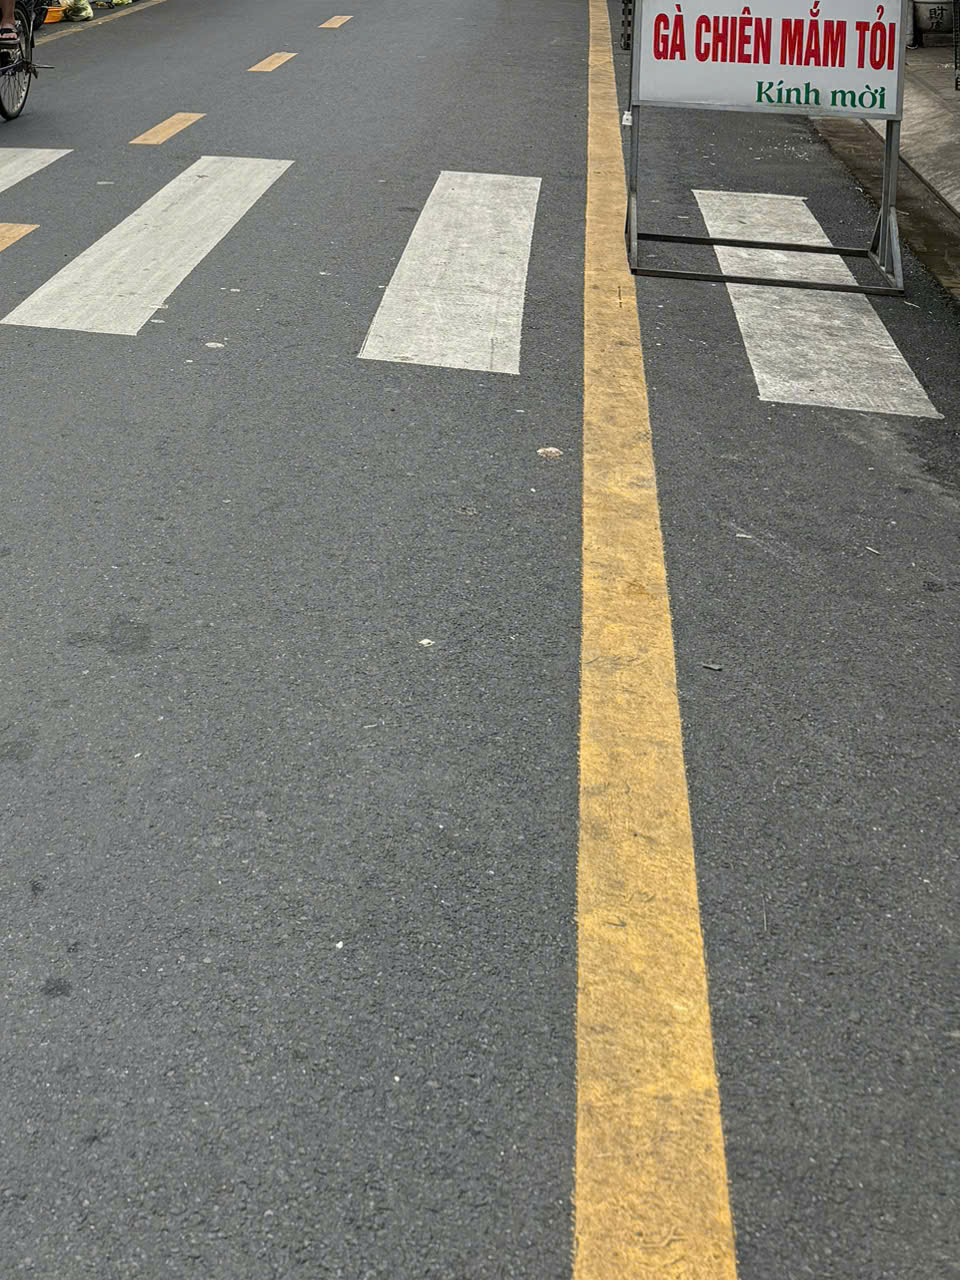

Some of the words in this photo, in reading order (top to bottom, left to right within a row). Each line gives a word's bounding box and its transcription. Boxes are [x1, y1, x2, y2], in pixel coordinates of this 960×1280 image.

[653, 4, 687, 61] GÀ
[694, 6, 772, 65] CHIÊN
[780, 0, 847, 68] MẮM
[855, 4, 896, 71] TỎI
[755, 79, 821, 106] Kính
[830, 84, 887, 110] mời
